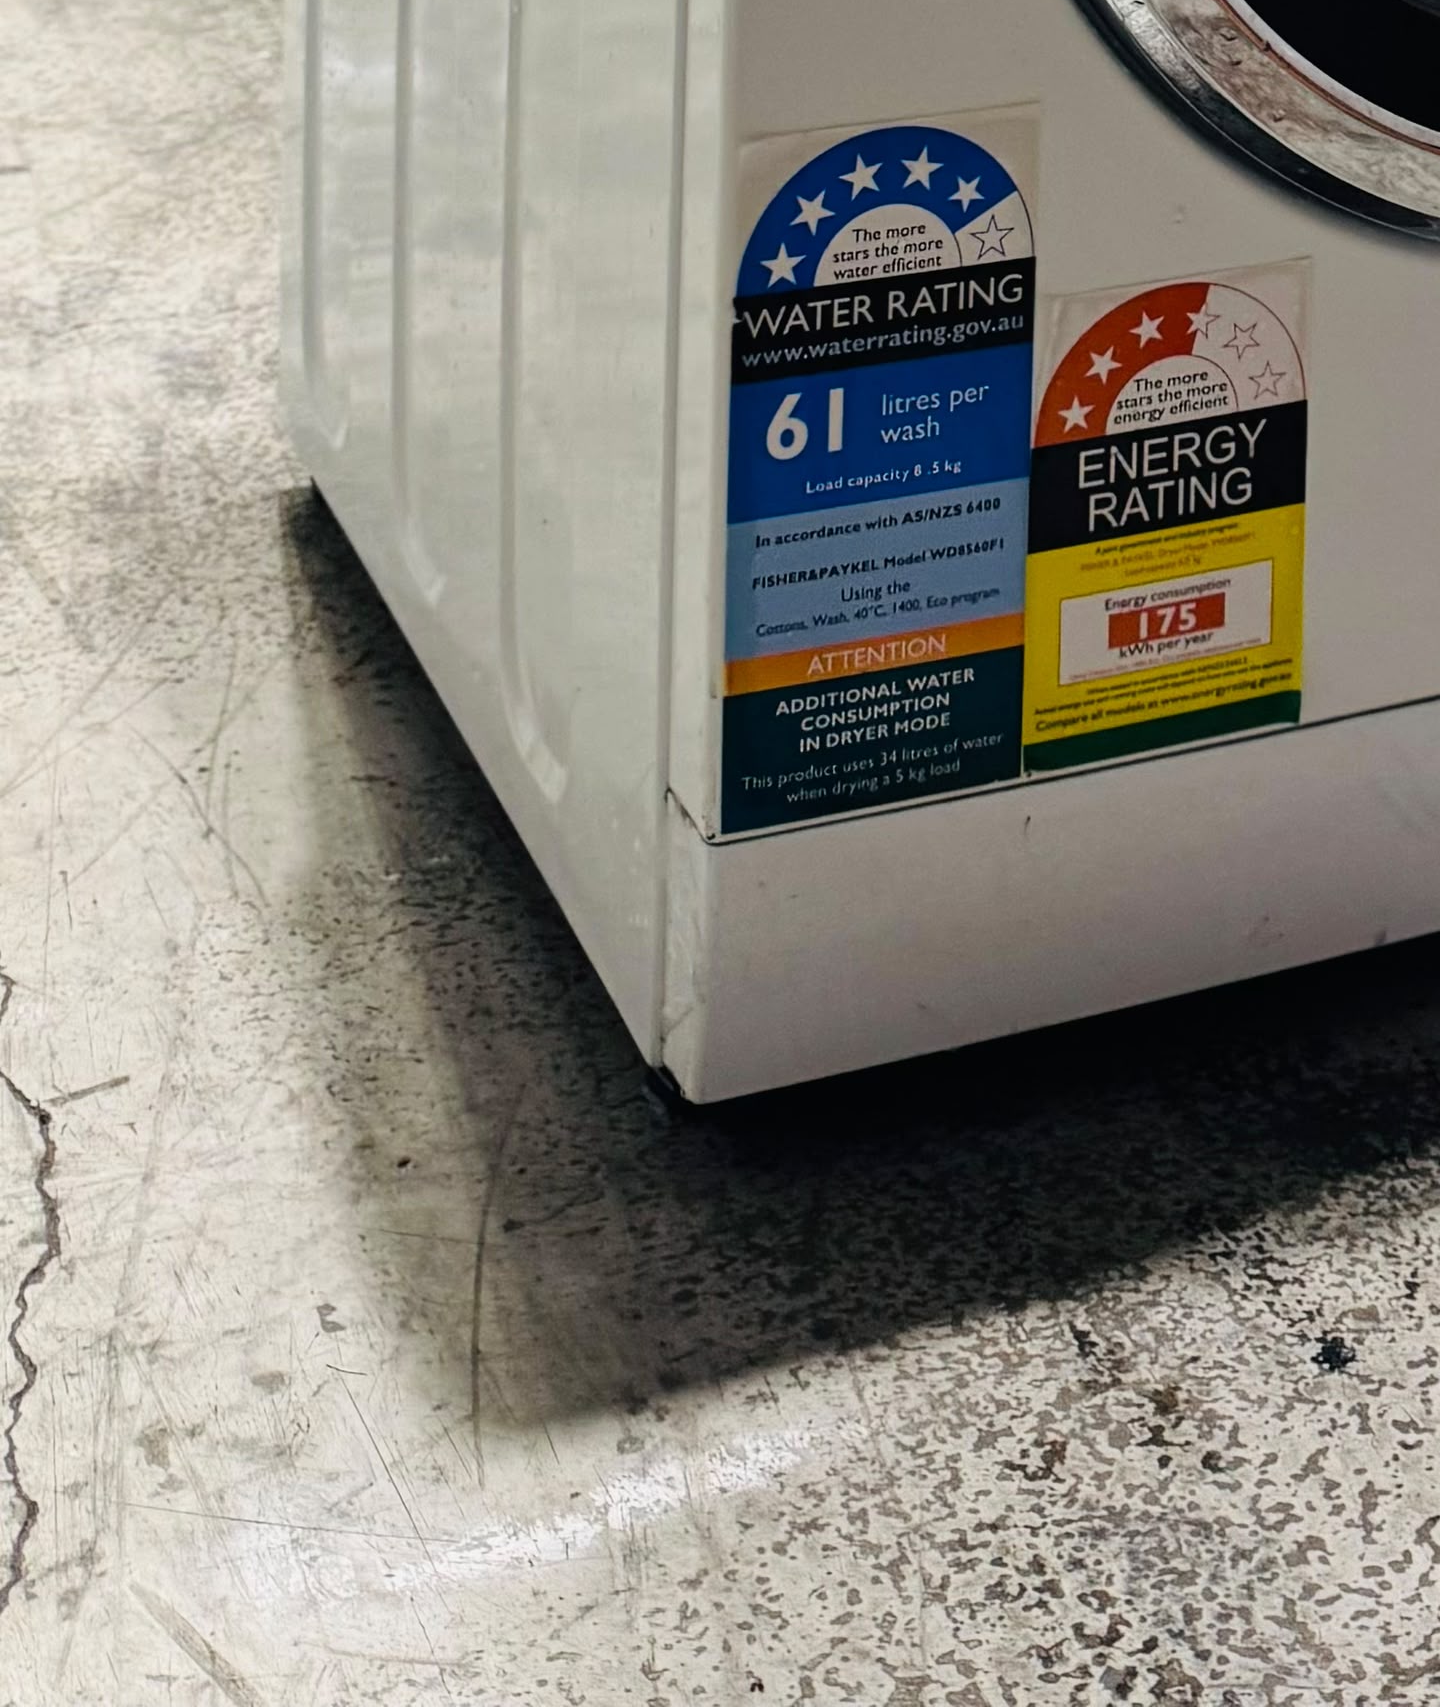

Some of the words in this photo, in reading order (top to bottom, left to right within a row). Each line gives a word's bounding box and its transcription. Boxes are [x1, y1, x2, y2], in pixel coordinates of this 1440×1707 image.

[833, 247, 870, 263] stars
[874, 242, 900, 258] the
[903, 238, 944, 254] more
[852, 227, 887, 245] The
[888, 223, 927, 239] more
[834, 264, 878, 282] water
[882, 255, 943, 275] efficient
[743, 294, 874, 339] WATER
[887, 273, 1023, 322] RATING
[742, 314, 1024, 368] www.waterrating.gov.au
[1116, 394, 1153, 411] stars
[1158, 388, 1183, 403] the
[1186, 381, 1228, 399] more
[1133, 378, 1163, 393] The
[1166, 370, 1209, 388] more
[881, 390, 941, 417] litres
[950, 384, 990, 412] per
[1113, 407, 1165, 425] energy
[1169, 395, 1229, 416] efficient
[765, 387, 845, 462] 61
[881, 416, 941, 444] wash
[1078, 418, 1267, 490] ENERGY
[805, 475, 843, 494] Load
[847, 468, 909, 490] capacity
[944, 459, 962, 474] kg
[1088, 466, 1253, 533] RATING
[755, 533, 771, 549] In
[774, 520, 862, 546] accordance
[865, 515, 899, 532] with
[901, 502, 962, 526] AS/NZS
[966, 496, 1002, 515] 6400
[751, 558, 880, 591] FISHER&PAYKEL
[884, 551, 928, 569] Model
[840, 584, 884, 604] Using
[887, 580, 911, 596] the
[926, 595, 949, 609] Eco
[1104, 591, 1148, 611] Energy
[1151, 576, 1232, 602] consumption
[1138, 603, 1198, 640] 175
[807, 634, 948, 675] ATTENTION
[1119, 641, 1154, 659] kWh
[1157, 639, 1183, 654] per
[1184, 632, 1214, 649] year
[775, 681, 902, 717] ADDITIONAL
[907, 667, 976, 691] WATER
[800, 692, 951, 732] CONSUMPTION
[1035, 711, 1089, 732] Compare
[1091, 710, 1104, 721] all
[1106, 701, 1145, 718] models
[799, 737, 820, 753] IN
[826, 723, 889, 748] DRYER
[894, 711, 951, 736] MODE
[742, 773, 775, 791] This
[778, 764, 838, 789] product
[843, 758, 875, 773] uses
[880, 750, 898, 767] 34
[902, 744, 939, 762] litres
[943, 737, 960, 754] of
[961, 733, 1004, 751] water
[787, 787, 827, 803] when
[832, 775, 880, 796] drying
[883, 775, 891, 786] a
[896, 769, 904, 783] 5
[908, 765, 926, 784] kg
[930, 758, 961, 776] load
